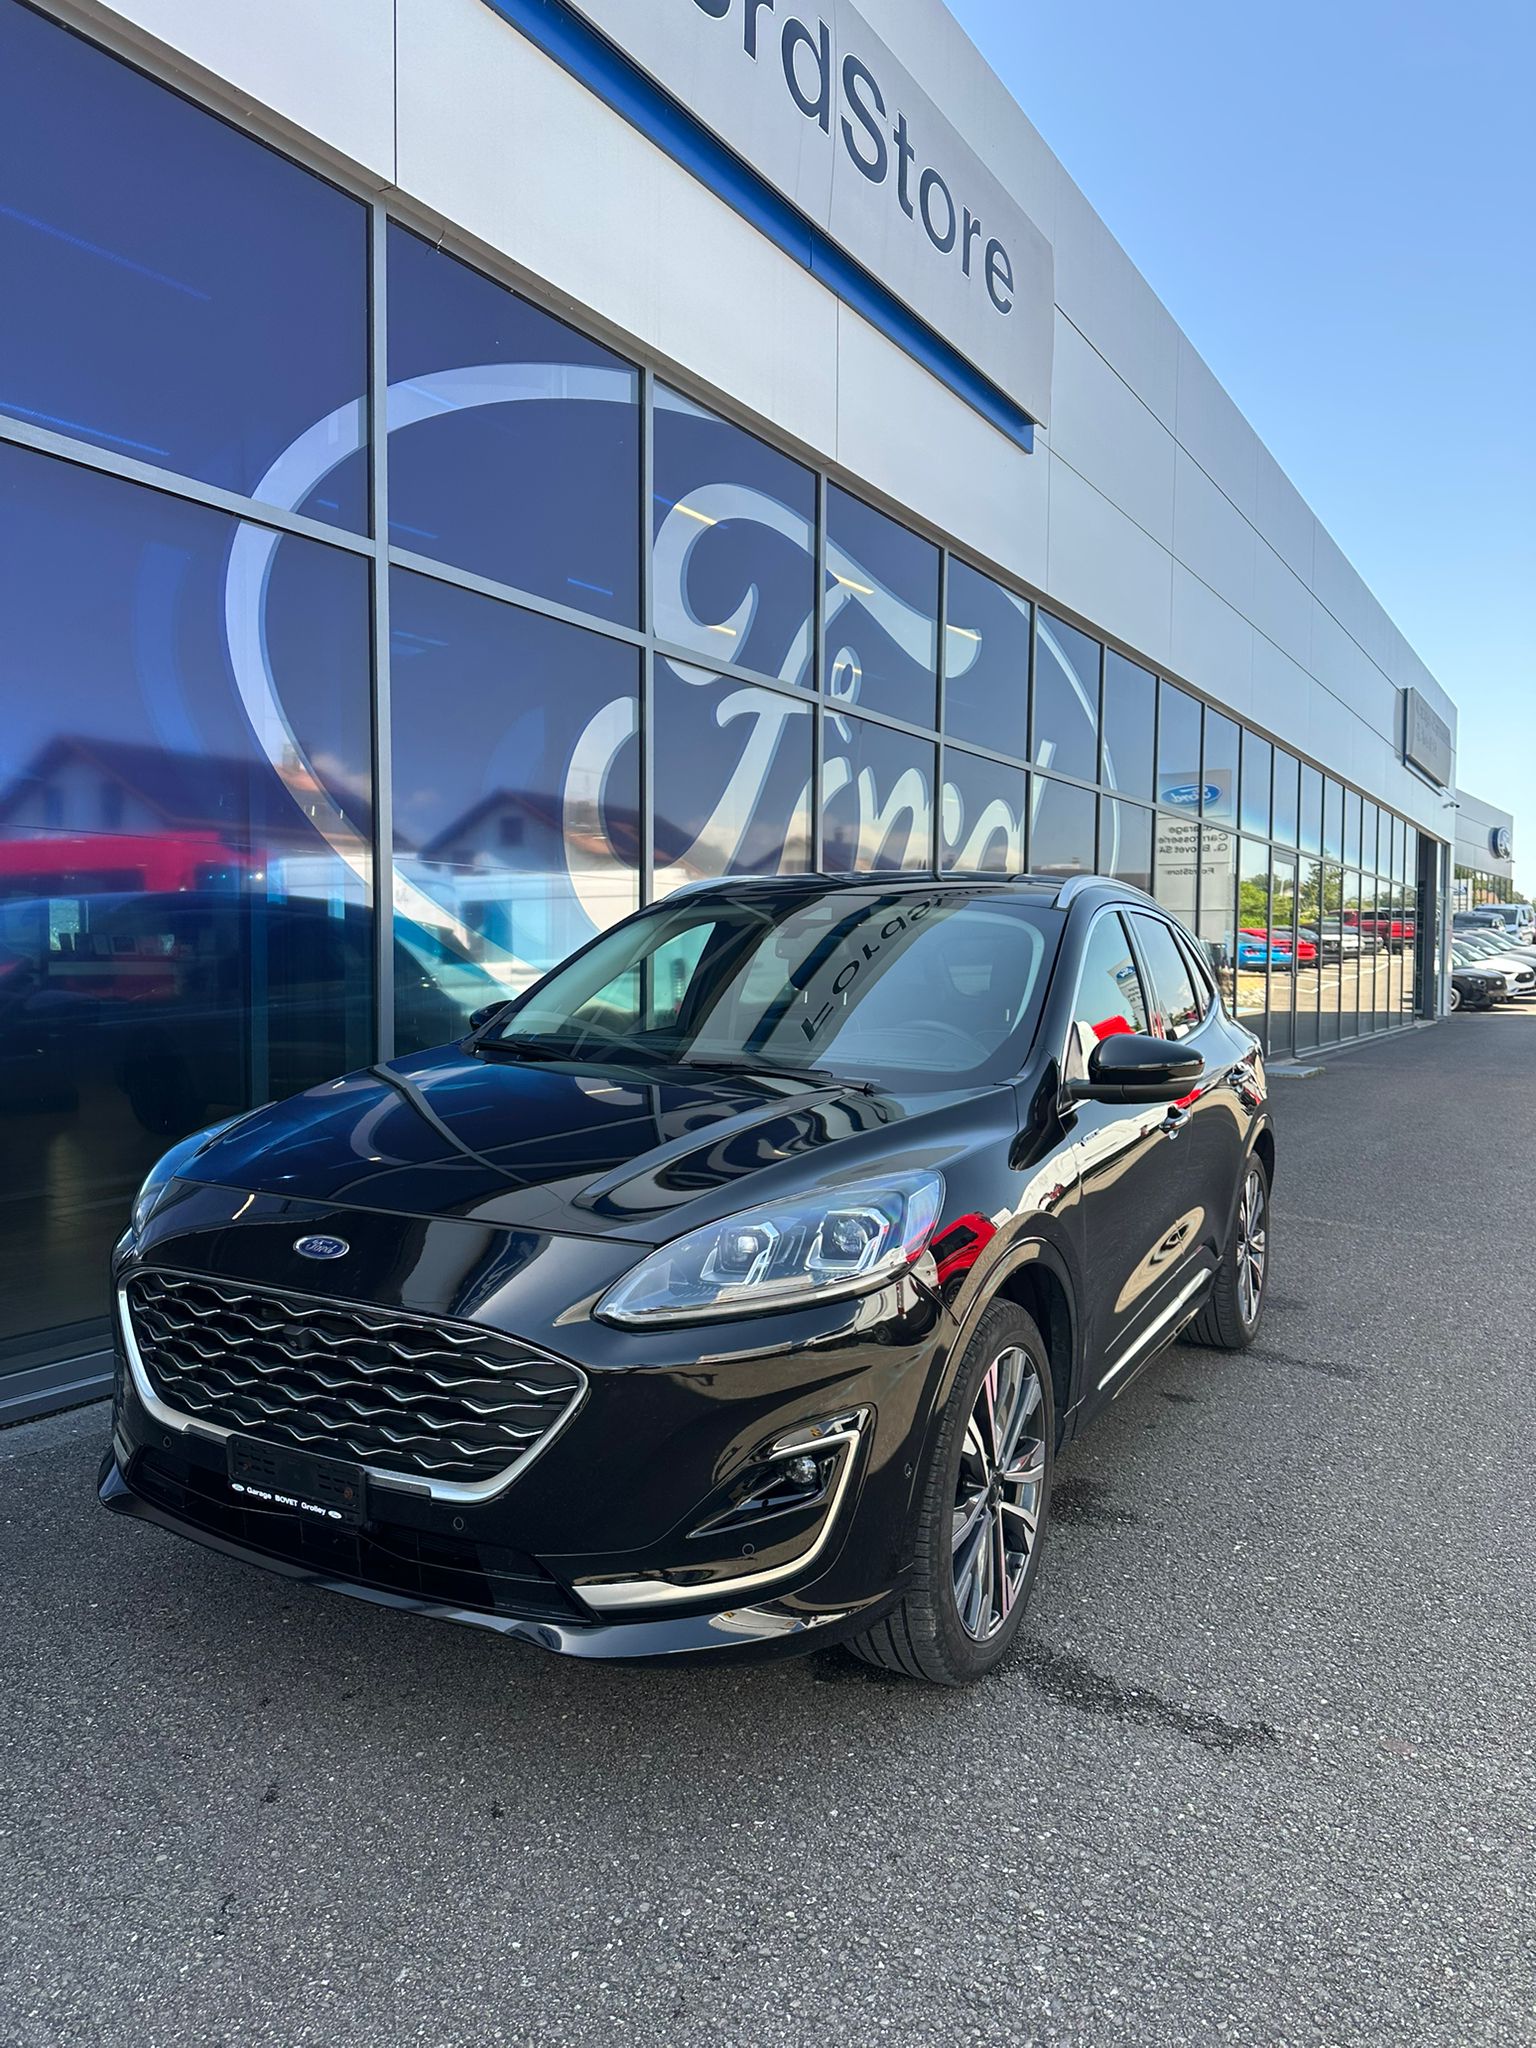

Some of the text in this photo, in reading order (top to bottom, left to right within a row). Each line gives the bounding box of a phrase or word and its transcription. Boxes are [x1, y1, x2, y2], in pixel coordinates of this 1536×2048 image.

[692, 0, 1014, 316] rdStore
[562, 483, 1055, 934] Ford
[246, 1486, 272, 1500] Garage
[274, 1494, 299, 1507] BOVET
